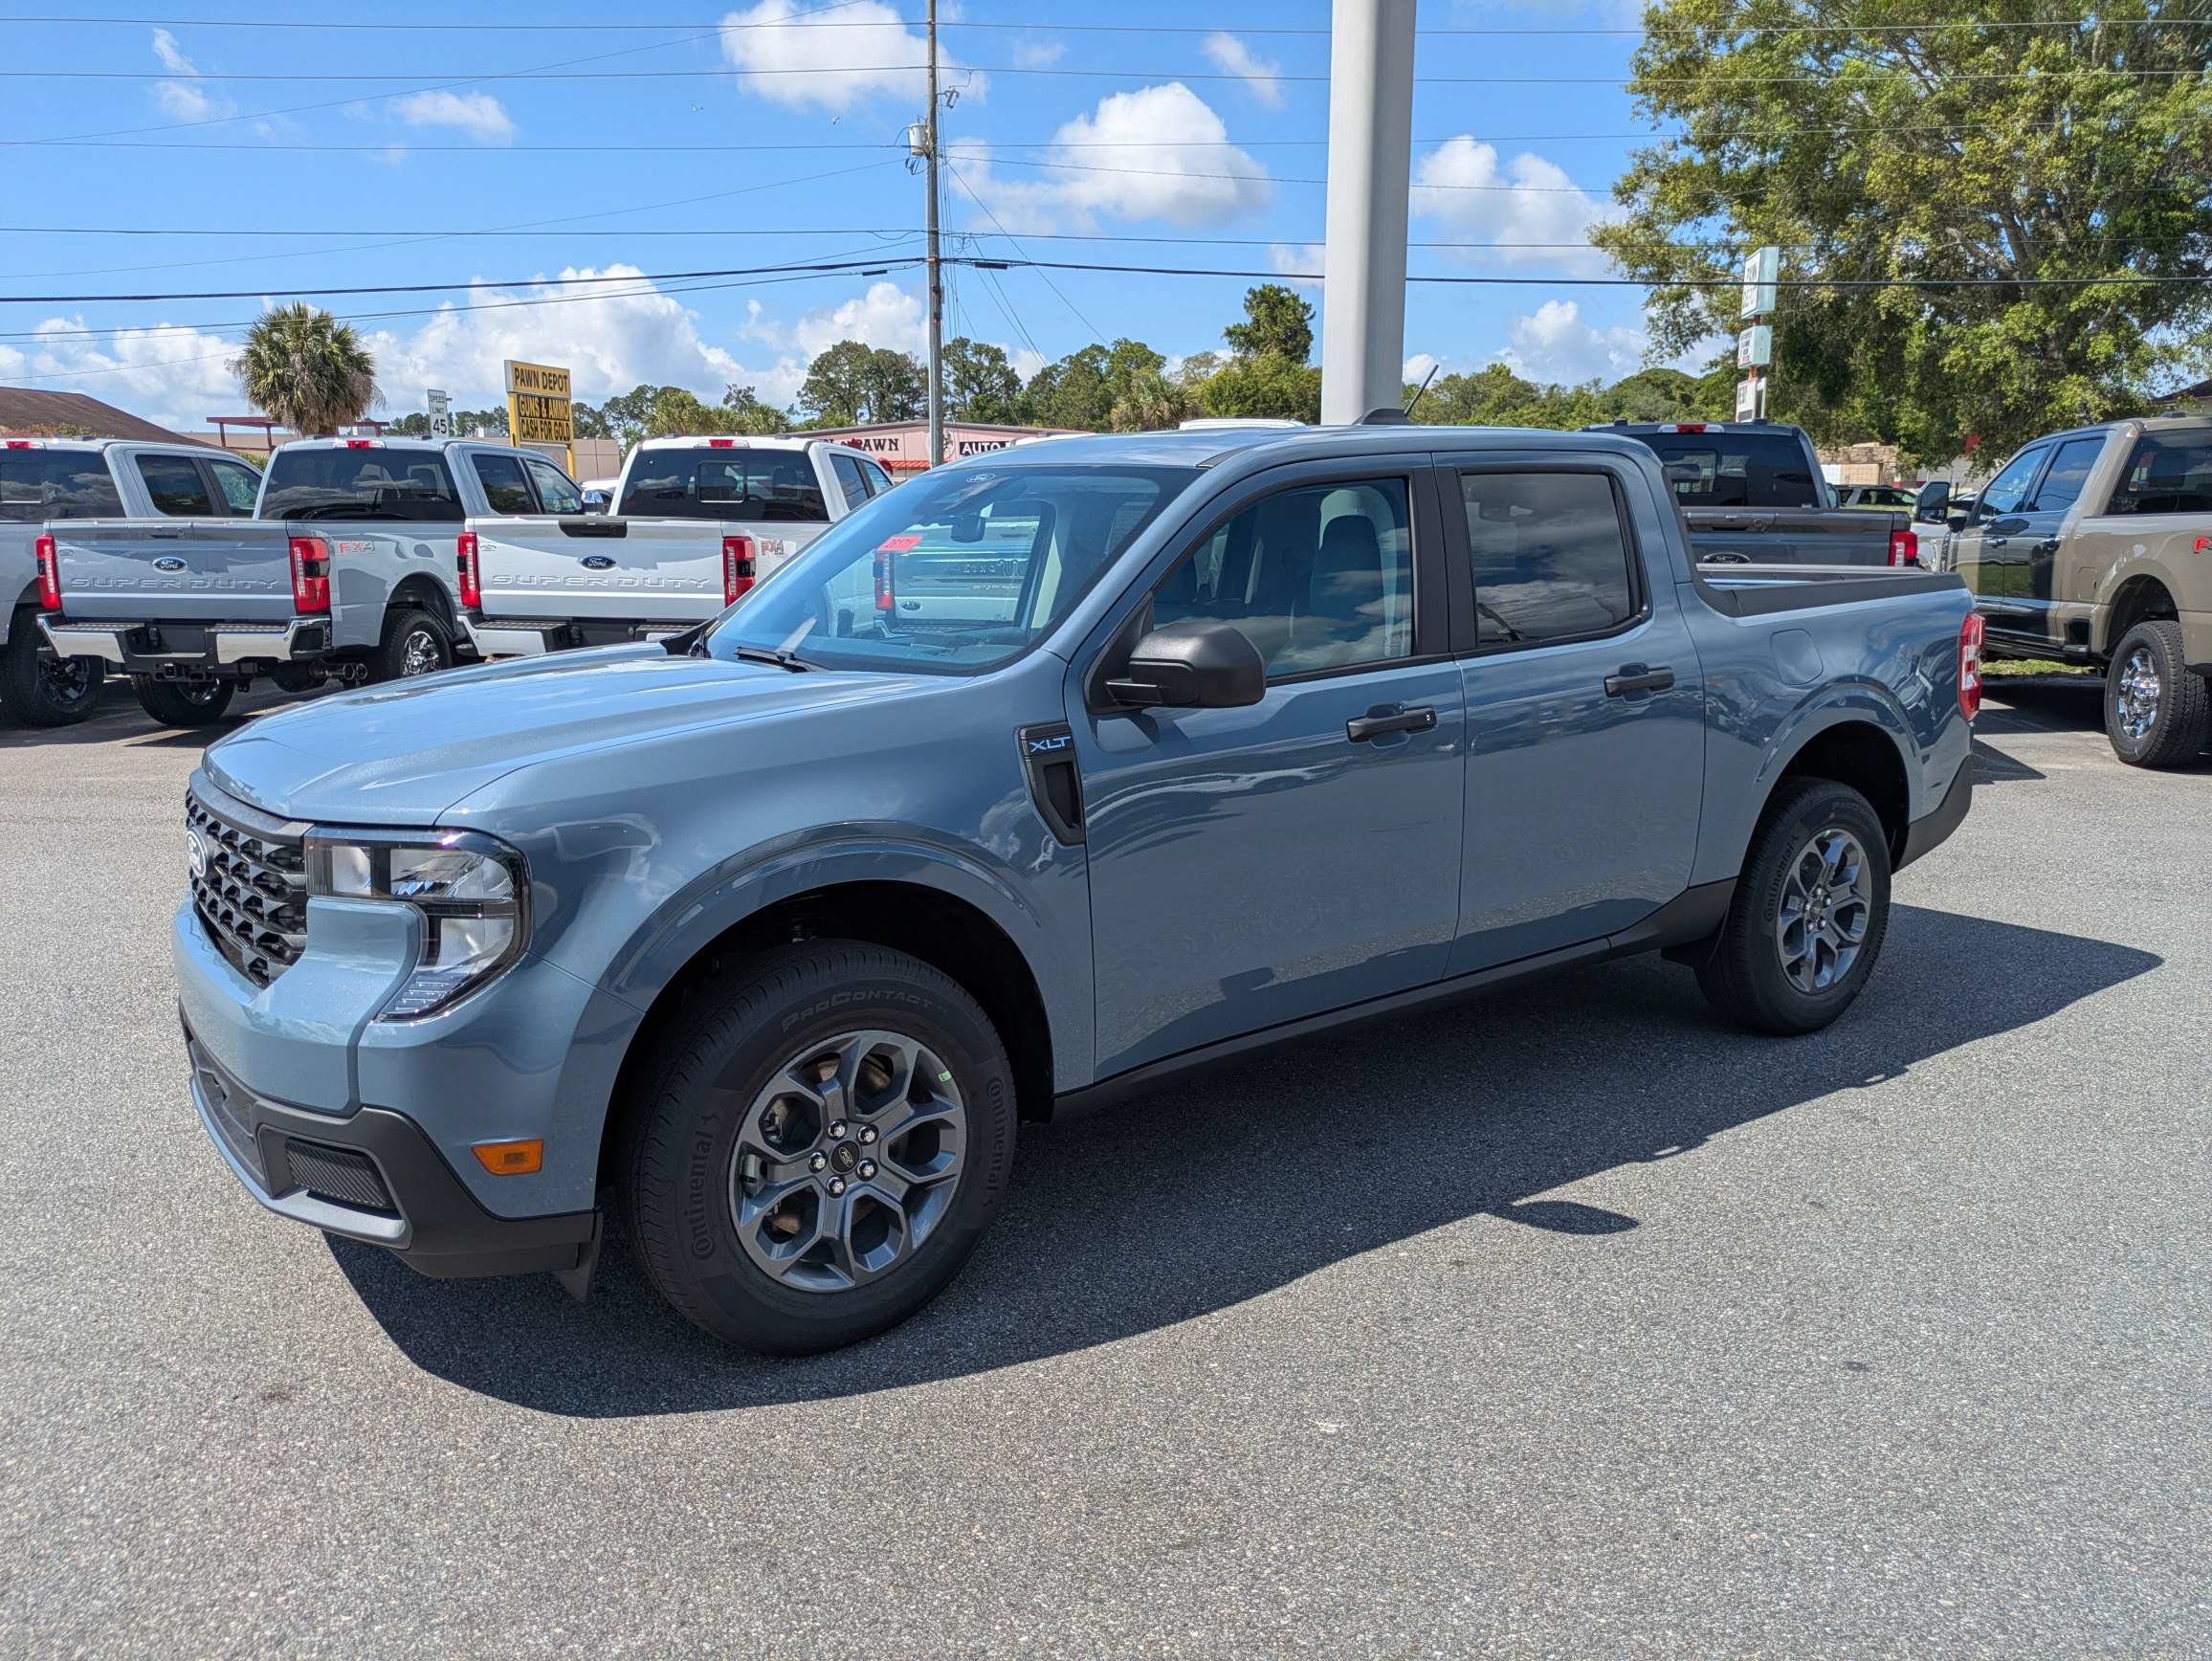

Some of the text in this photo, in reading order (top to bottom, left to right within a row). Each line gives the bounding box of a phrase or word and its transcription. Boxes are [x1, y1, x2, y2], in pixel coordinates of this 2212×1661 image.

[515, 367, 567, 392] PAWN DEPOT
[520, 394, 569, 420] GUNS & AMMO
[432, 418, 447, 434] 45
[520, 419, 571, 442] CASH FOR GOLD
[339, 542, 375, 554] FX4
[70, 577, 279, 589] SUPER DUTY
[491, 574, 710, 589] SUPER DUTY
[1029, 736, 1072, 753] XLT
[1763, 843, 1798, 921] Continental
[986, 1076, 1007, 1192] Continental
[683, 1130, 717, 1261] Continental
